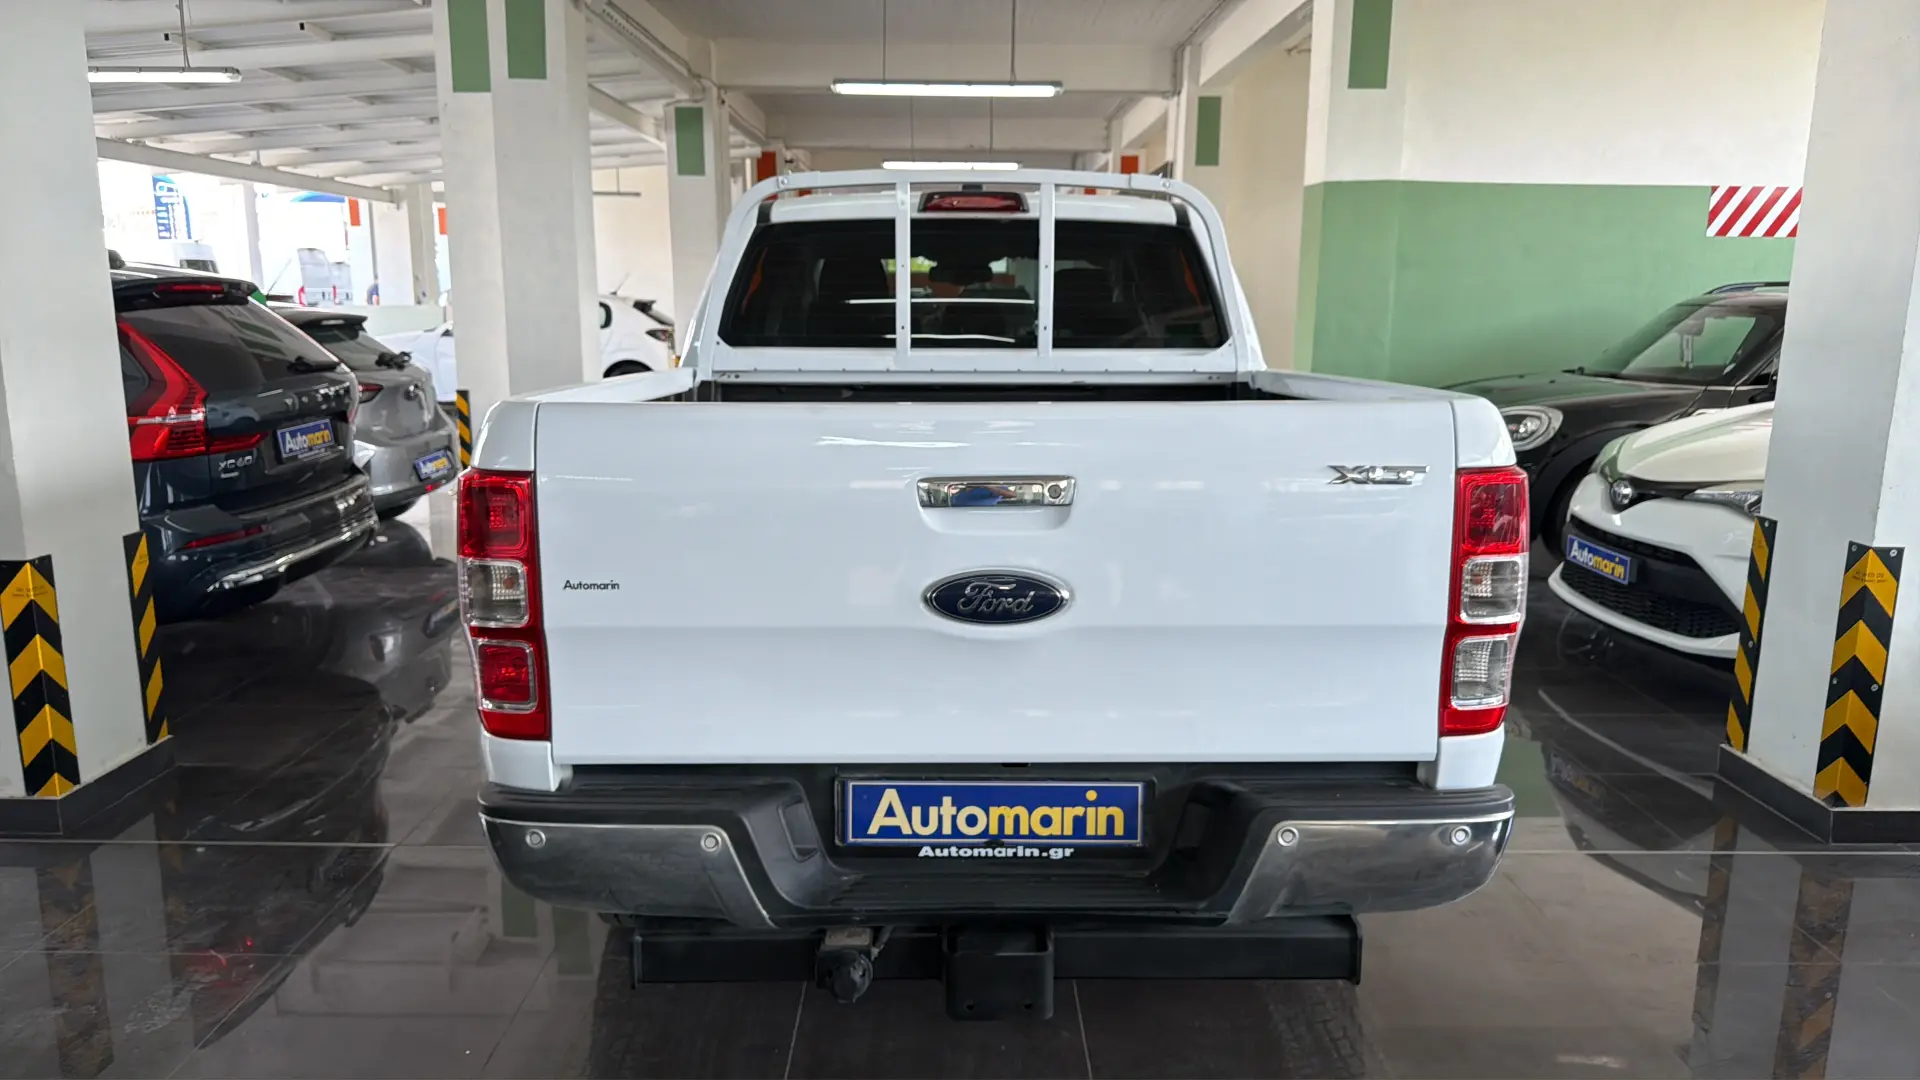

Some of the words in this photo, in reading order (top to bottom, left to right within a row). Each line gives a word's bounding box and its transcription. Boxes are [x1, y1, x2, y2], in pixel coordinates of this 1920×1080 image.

[285, 424, 332, 453] Automarin
[1570, 540, 1625, 579] Automarin
[562, 579, 620, 590] Automarin
[957, 576, 1036, 613] Ford
[867, 788, 1124, 835] Automarin
[918, 845, 1074, 860] Automarin.gr
